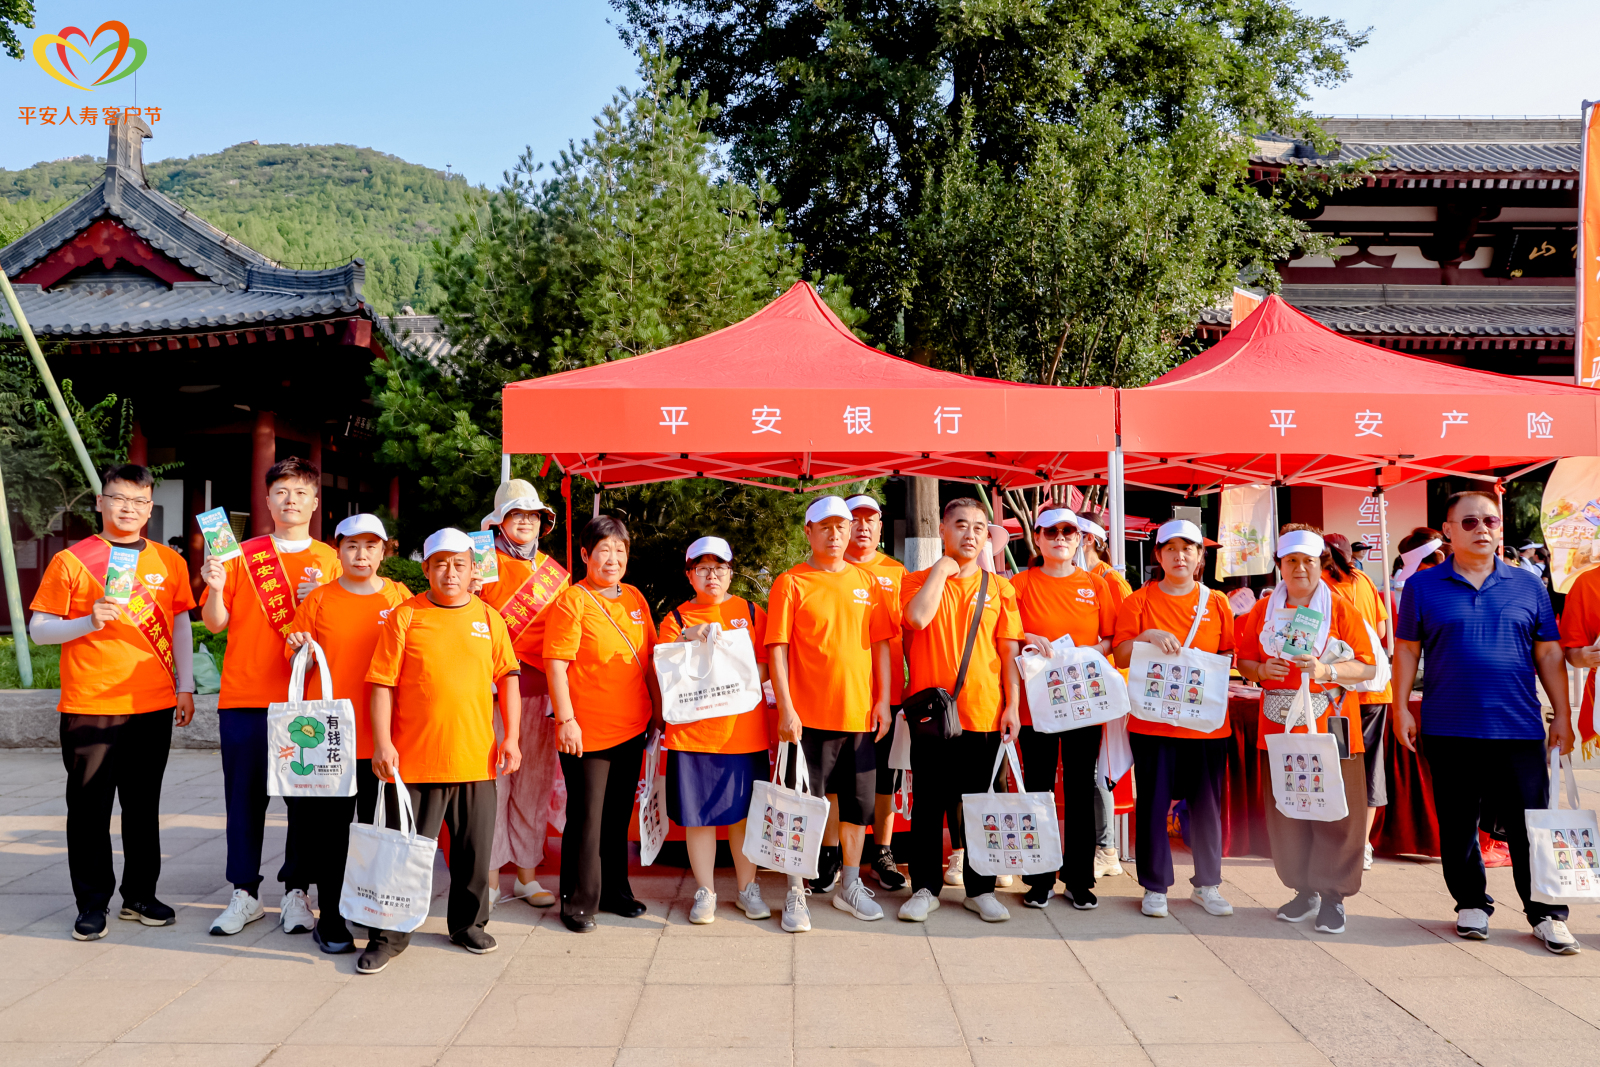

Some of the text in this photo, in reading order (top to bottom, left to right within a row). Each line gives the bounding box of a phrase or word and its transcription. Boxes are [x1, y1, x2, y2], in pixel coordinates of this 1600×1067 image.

[659, 404, 963, 435] 平安银行
[1269, 409, 1554, 439] 平安产险
[1357, 496, 1390, 562] 生活
[504, 565, 560, 629] 平安银行济南
[326, 715, 341, 763] 有钱花
